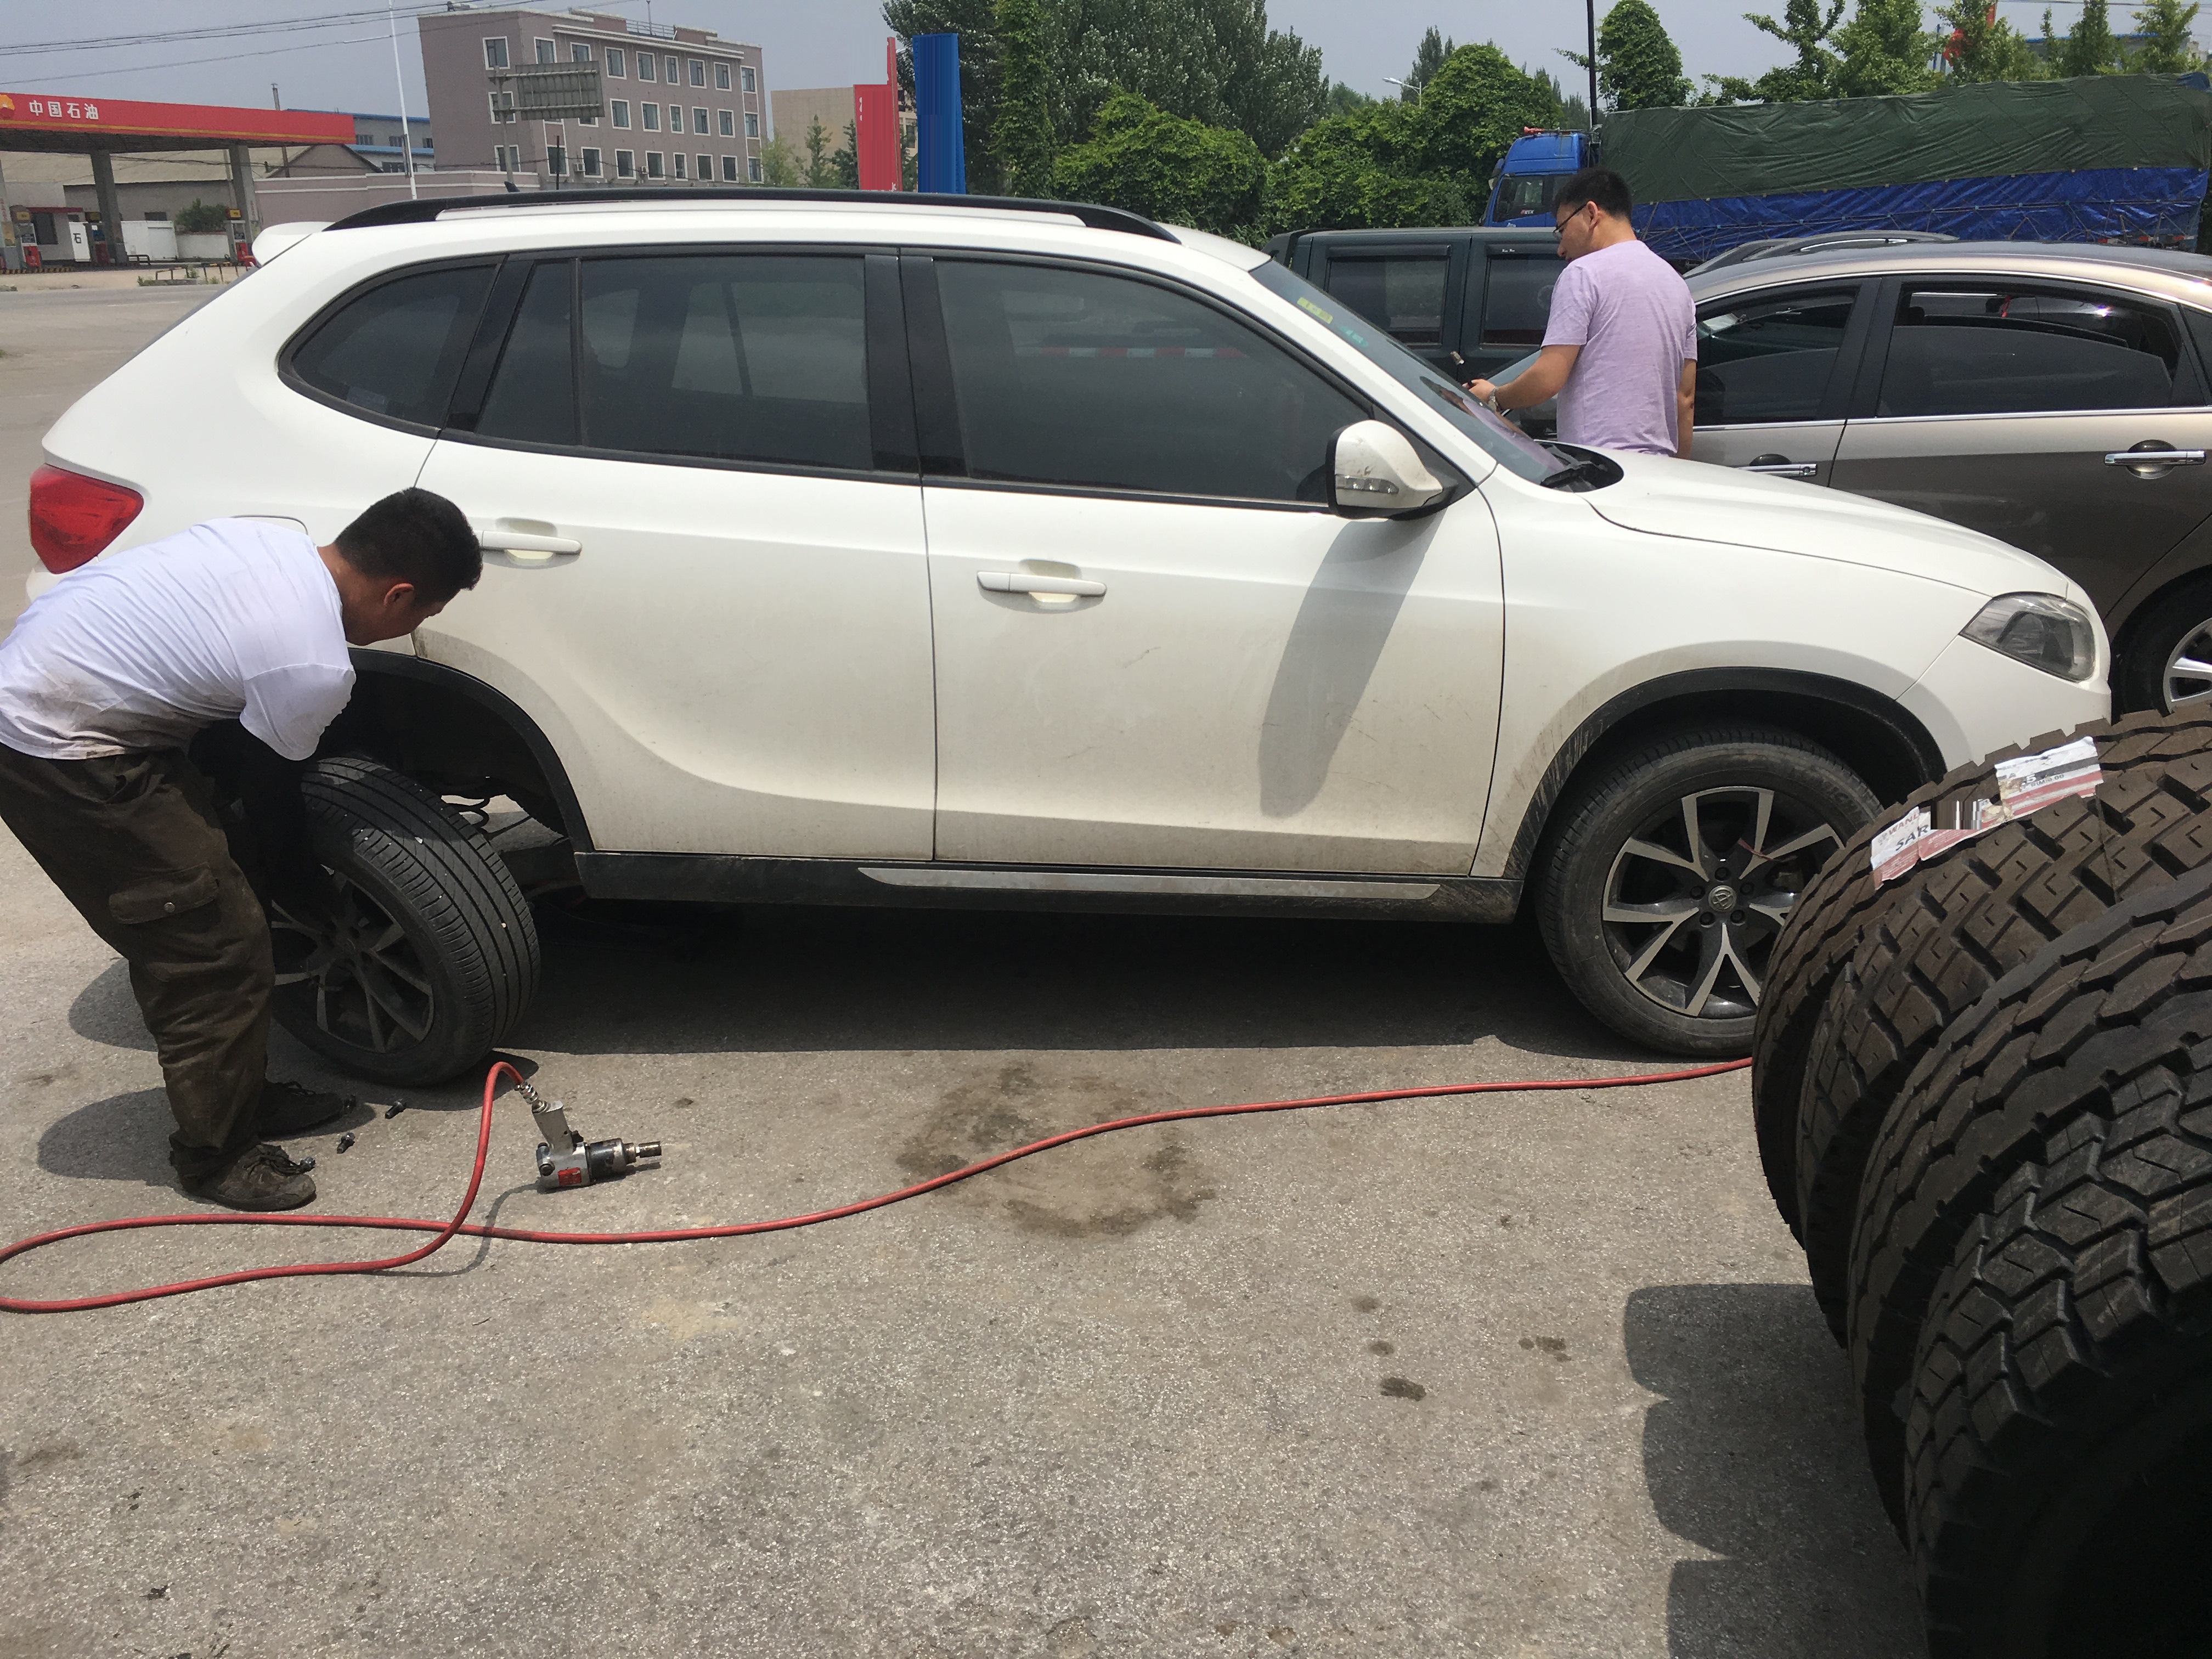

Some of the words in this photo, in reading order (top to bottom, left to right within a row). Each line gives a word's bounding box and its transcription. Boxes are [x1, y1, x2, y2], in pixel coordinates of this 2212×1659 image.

[29, 100, 99, 120] 中国石油
[1889, 813, 1920, 835] WANL
